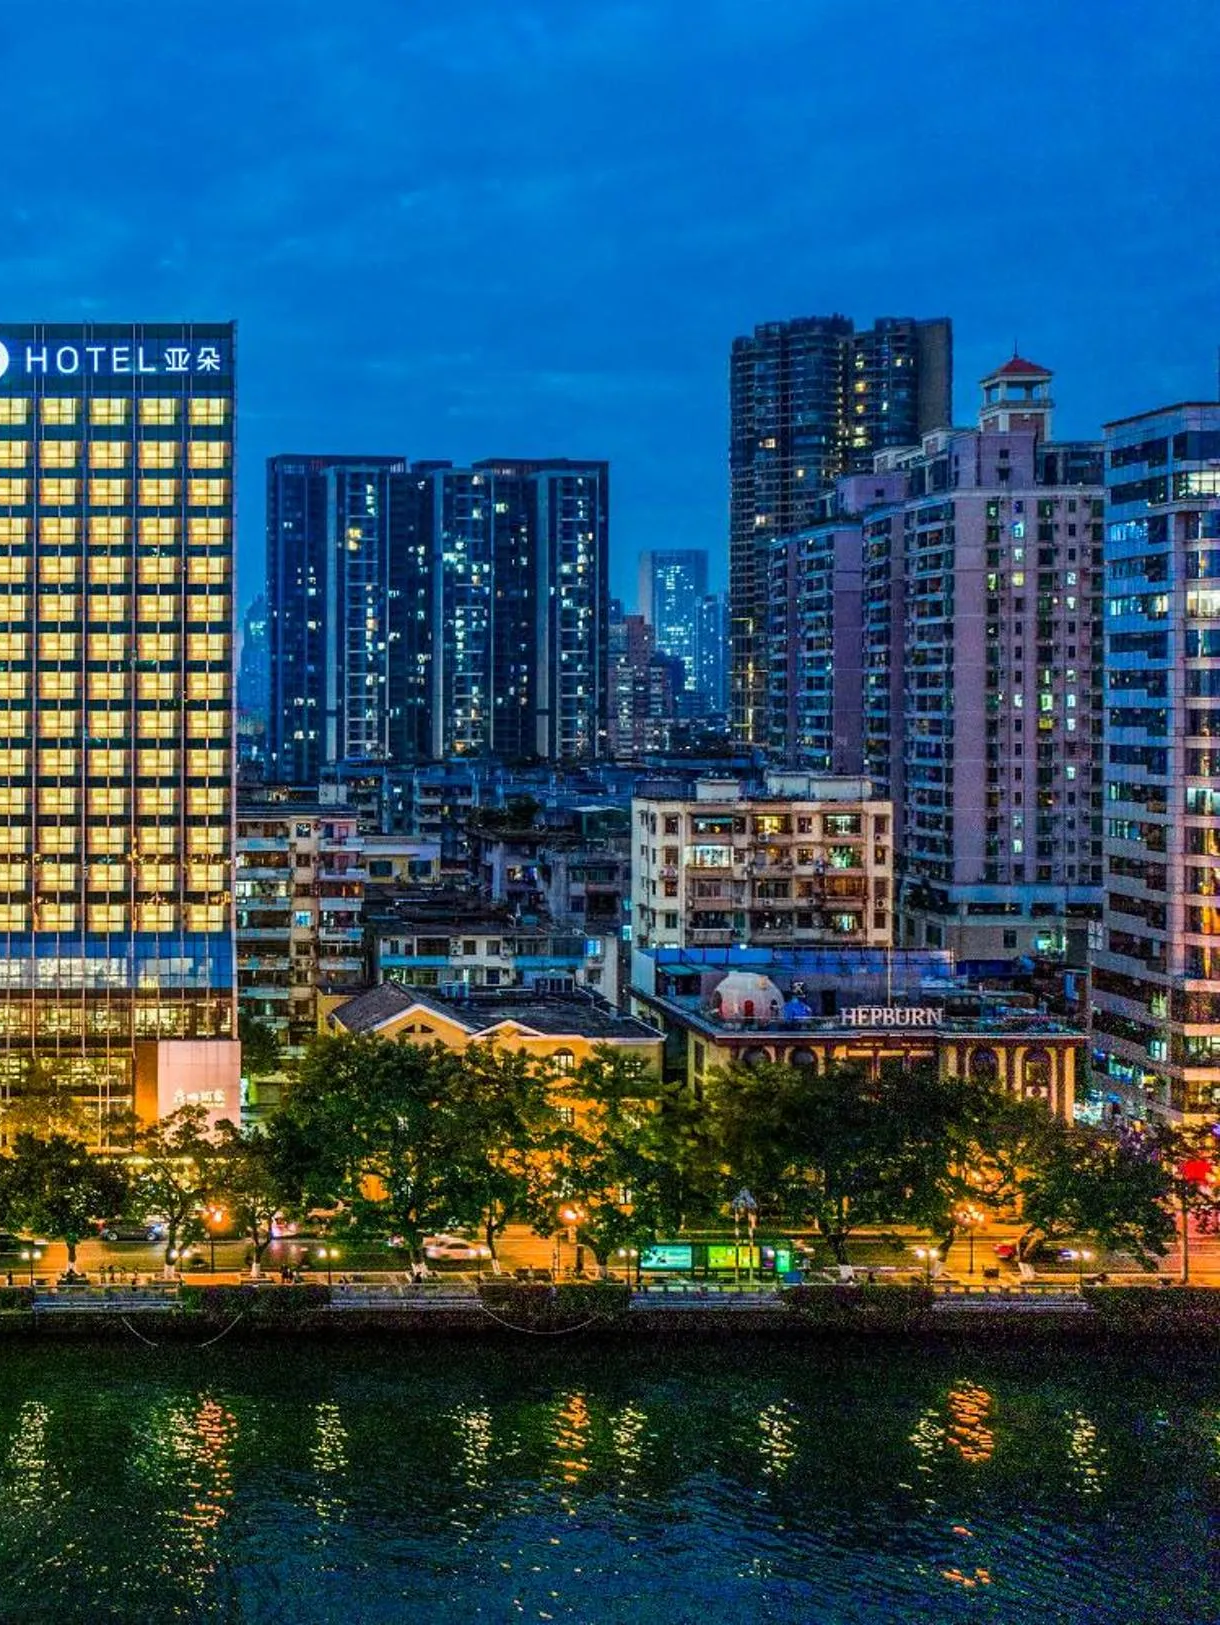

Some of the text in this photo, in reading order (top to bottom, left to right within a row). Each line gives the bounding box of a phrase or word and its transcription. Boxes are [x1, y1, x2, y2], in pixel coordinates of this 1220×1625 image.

[26, 345, 156, 373] HOTEL
[164, 346, 221, 372] 亚朵
[840, 1006, 945, 1027] HEPBURN
